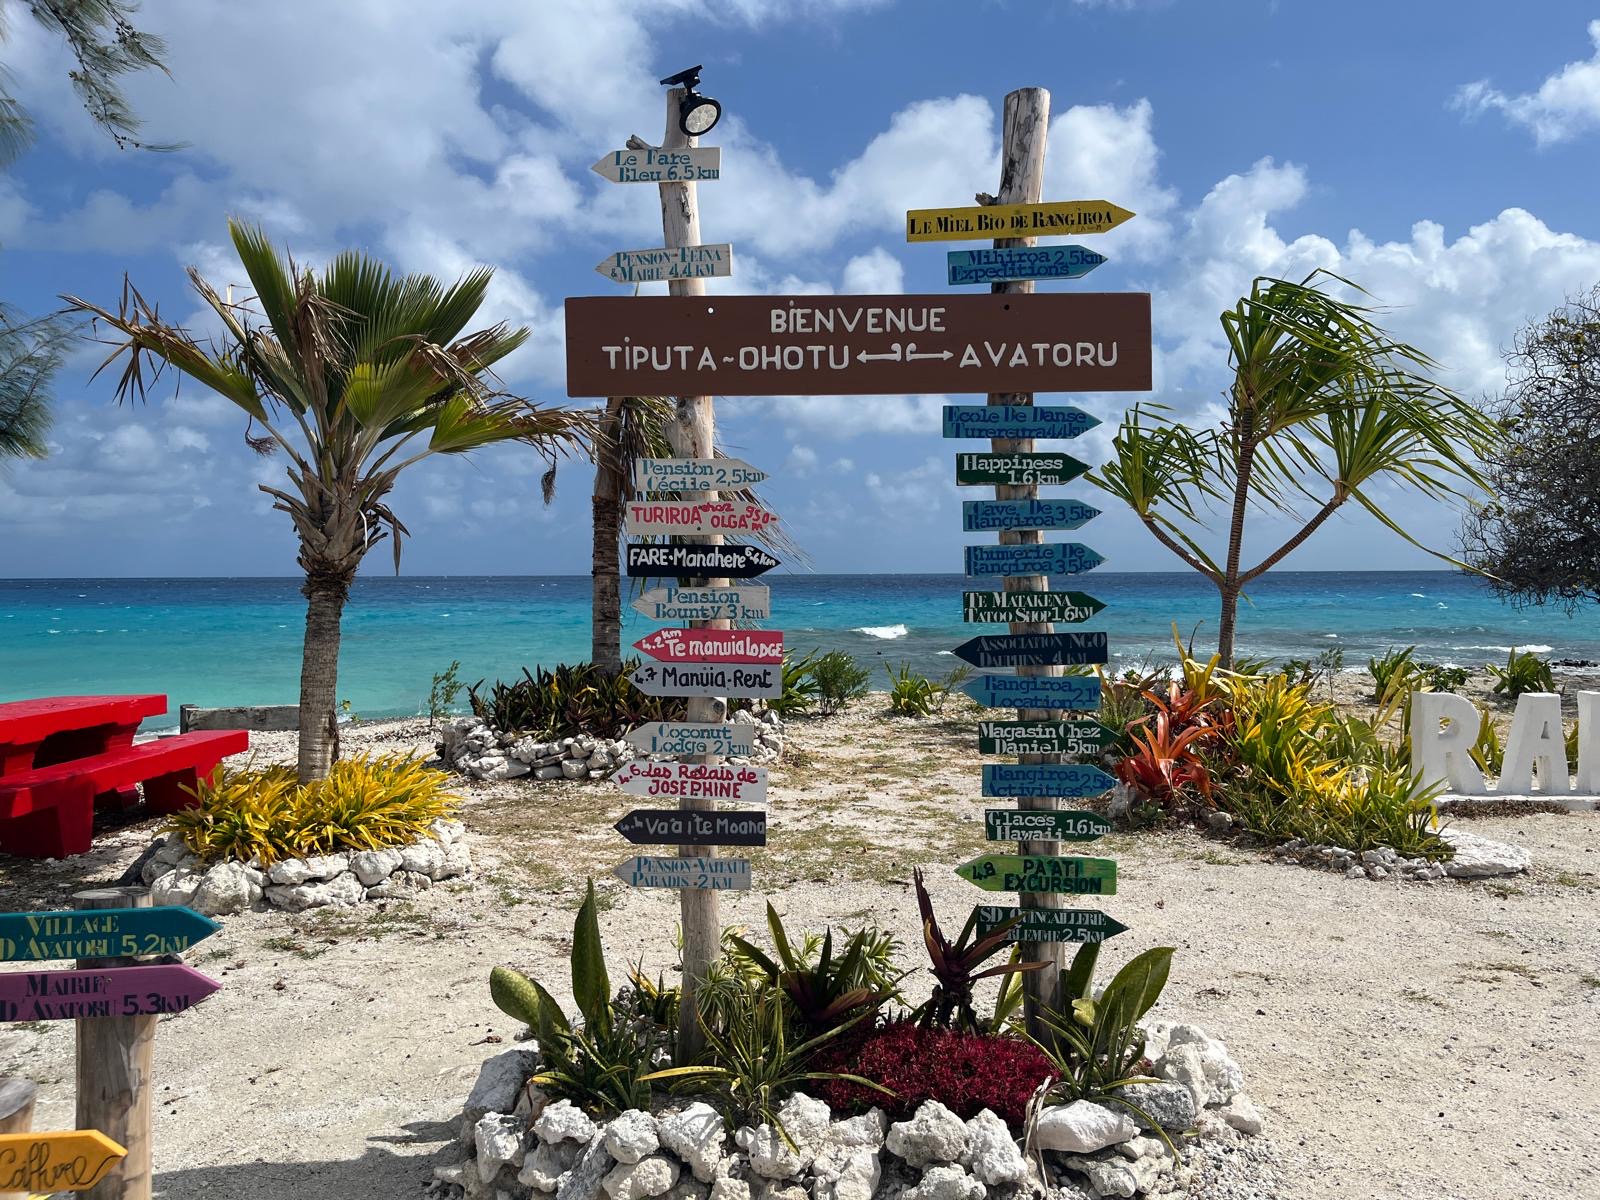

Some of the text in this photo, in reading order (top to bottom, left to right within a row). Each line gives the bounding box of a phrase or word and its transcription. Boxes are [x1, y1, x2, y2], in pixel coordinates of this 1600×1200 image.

[615, 149, 691, 166] Le Fare
[619, 167, 662, 183] Bleu
[697, 166, 720, 180] km
[909, 218, 932, 235] LE
[1010, 214, 1029, 229] DE
[615, 250, 671, 268] PENSION
[610, 268, 618, 278] &
[620, 265, 664, 281] MARIE
[951, 263, 1070, 282] Expeditions
[959, 340, 1118, 368] AVATORU
[641, 459, 714, 476] Pension
[962, 454, 1064, 474] Happiness
[646, 475, 711, 491] Cécile
[630, 505, 702, 525] TURIROA
[710, 514, 749, 529] OLGA
[967, 514, 1056, 531] Rangiroa
[966, 559, 1054, 577] Rangiroa
[667, 587, 740, 604] Pension
[965, 591, 1072, 608] TE MATAKENA
[655, 603, 765, 620] Bounty 3 km
[964, 607, 1013, 623] TATOO
[1015, 607, 1051, 623] SHOP
[661, 629, 682, 640] km
[976, 635, 1063, 651] ASSOCIATION
[664, 638, 687, 657] Te
[978, 652, 1044, 667] DAUPHINS
[1052, 650, 1063, 666] 4
[984, 675, 1075, 694] Rangiroa
[989, 692, 1073, 709] Location
[658, 723, 733, 740] Coconut
[979, 722, 1101, 741] Magasin Chez
[651, 736, 751, 757] Lodge 2 km
[1409, 690, 1600, 796] RA
[678, 764, 735, 782] Relais
[736, 767, 759, 784] de
[991, 765, 1080, 784] Rangiroa
[648, 779, 743, 799] JOSEPHINE
[986, 783, 1084, 798] Activities
[716, 817, 766, 835] Moana
[987, 811, 1056, 827] Glaces
[995, 825, 1065, 842] Hawaii
[636, 856, 691, 874] PENSION
[631, 871, 733, 890] PARADIS 2 KM
[1003, 873, 1103, 893] EXCURSION
[979, 906, 1003, 923] SD
[24, 915, 120, 937] VILLAGE
[0, 934, 115, 961] D'AVATORU
[25, 974, 109, 998] MAIRIE
[0, 998, 116, 1022] D'AVATORU
